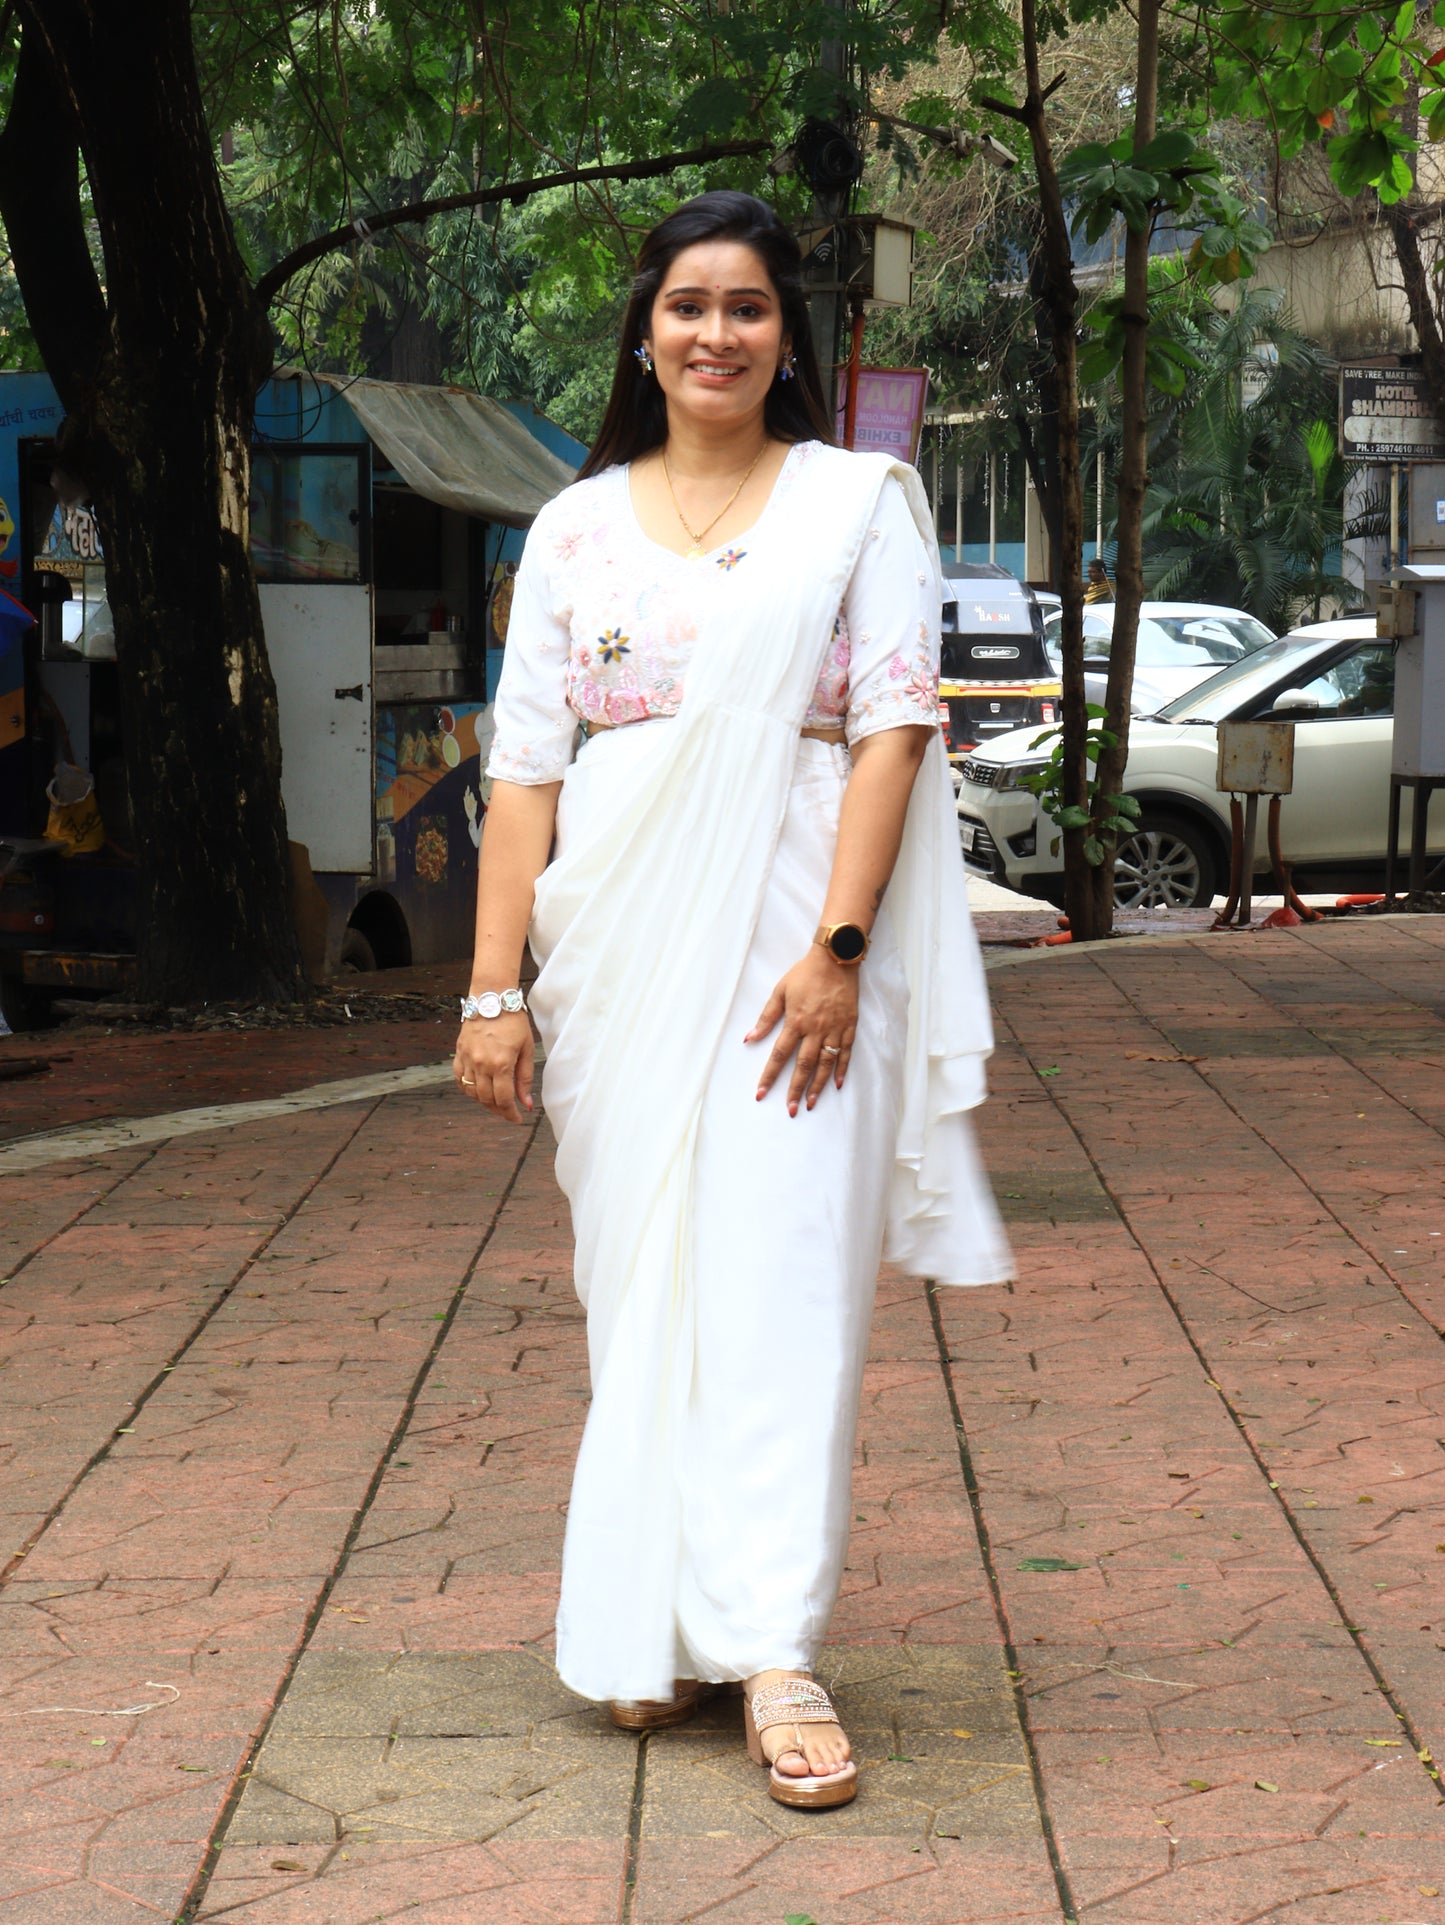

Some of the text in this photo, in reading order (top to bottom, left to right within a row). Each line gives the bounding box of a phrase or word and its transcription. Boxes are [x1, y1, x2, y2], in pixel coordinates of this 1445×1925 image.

[1344, 369, 1363, 378] SAVE
[1385, 371, 1405, 380] MAKE
[1375, 385, 1418, 400] HOTEL
